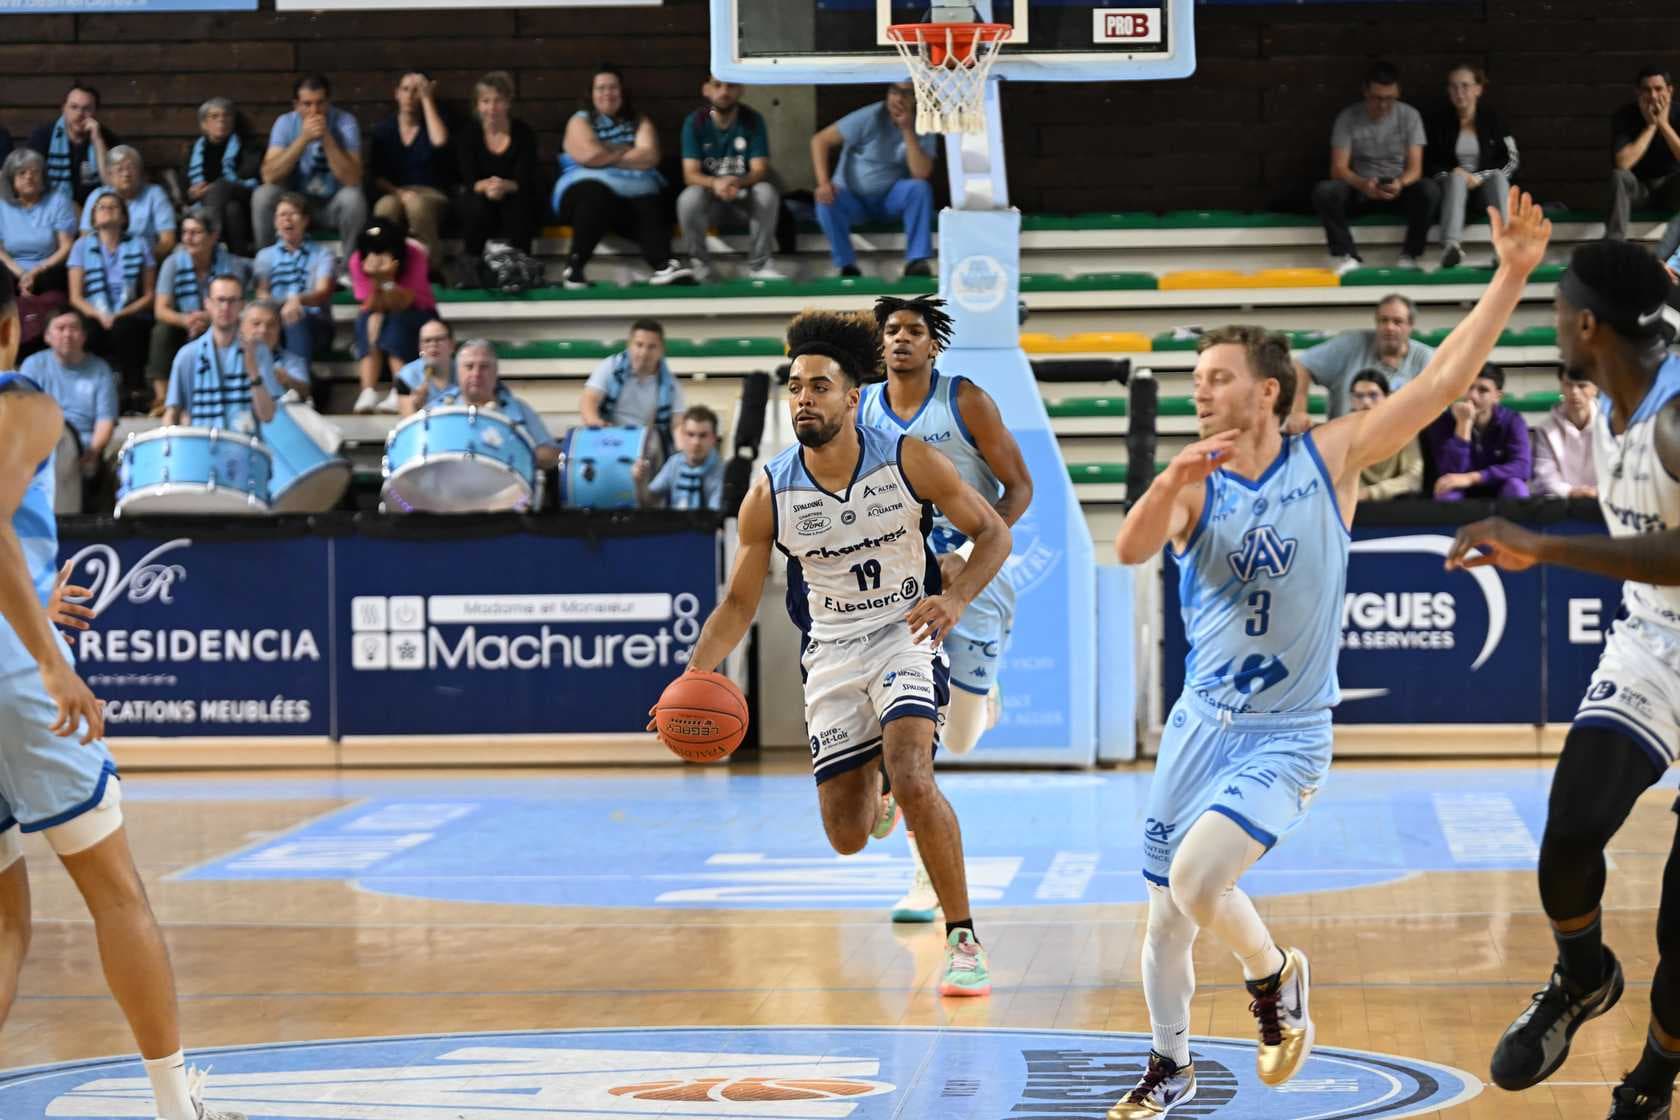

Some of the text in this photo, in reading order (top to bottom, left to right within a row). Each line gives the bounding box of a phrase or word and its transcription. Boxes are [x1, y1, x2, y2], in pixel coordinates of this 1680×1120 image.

[793, 499, 823, 512] SPALDING
[867, 502, 903, 517] AQUALTER
[803, 519, 824, 530] Ford
[849, 559, 882, 591] 19
[824, 591, 901, 614] E.Leclerc
[1245, 590, 1271, 636] 3
[79, 629, 320, 662] RESIDENCIA
[428, 625, 675, 670] Machuret
[1361, 631, 1456, 649] SERVICES
[201, 694, 311, 722] MEUBLÉES
[820, 727, 841, 739] Eure-
